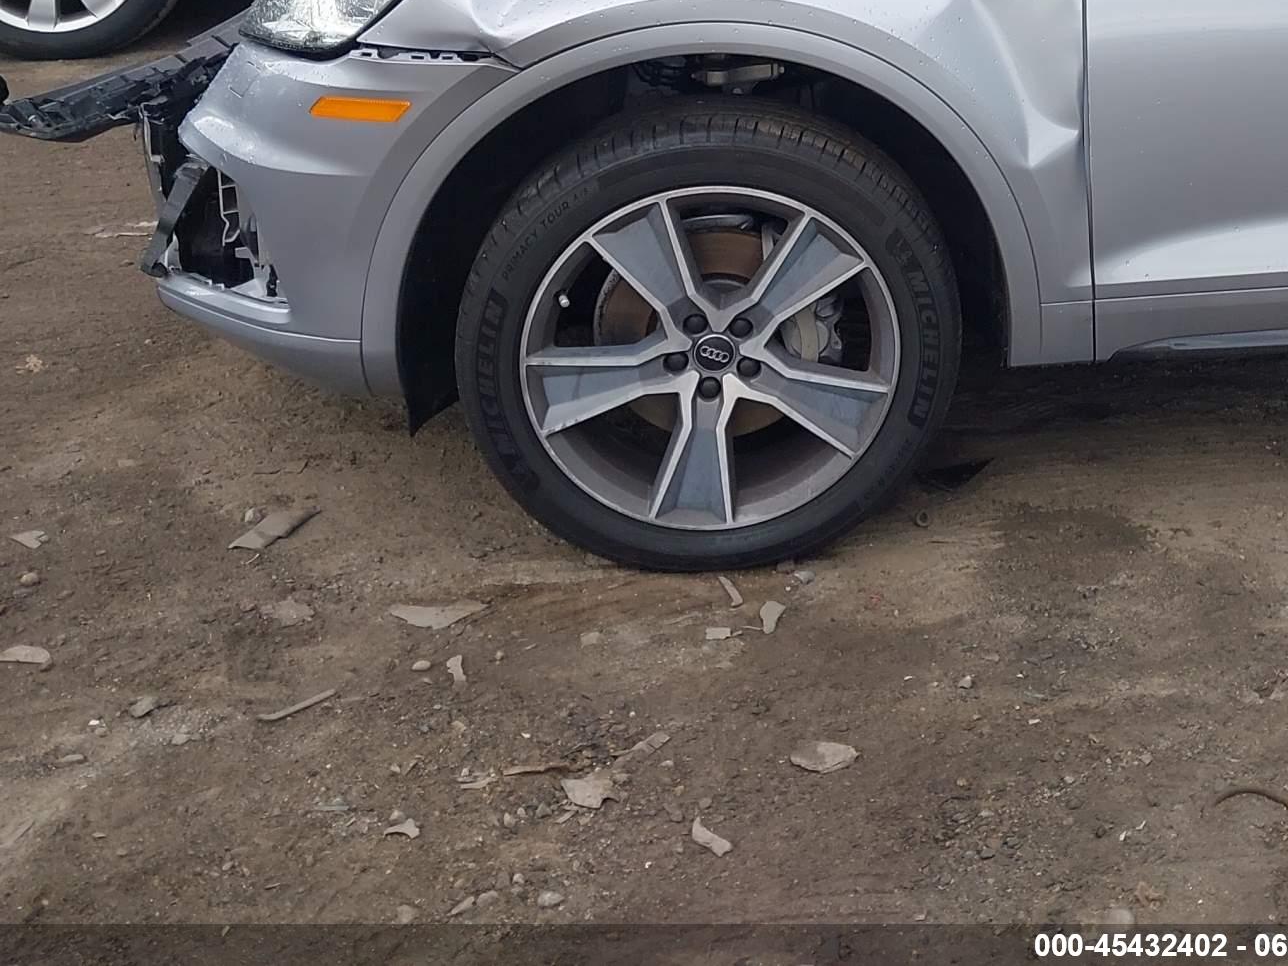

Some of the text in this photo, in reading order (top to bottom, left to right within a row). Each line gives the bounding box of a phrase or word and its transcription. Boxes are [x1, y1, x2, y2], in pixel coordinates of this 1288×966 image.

[502, 229, 538, 281] PRIMACY
[541, 201, 569, 227] TOUR
[479, 298, 517, 456] MICHELIN
[906, 269, 941, 421] MICHELIN
